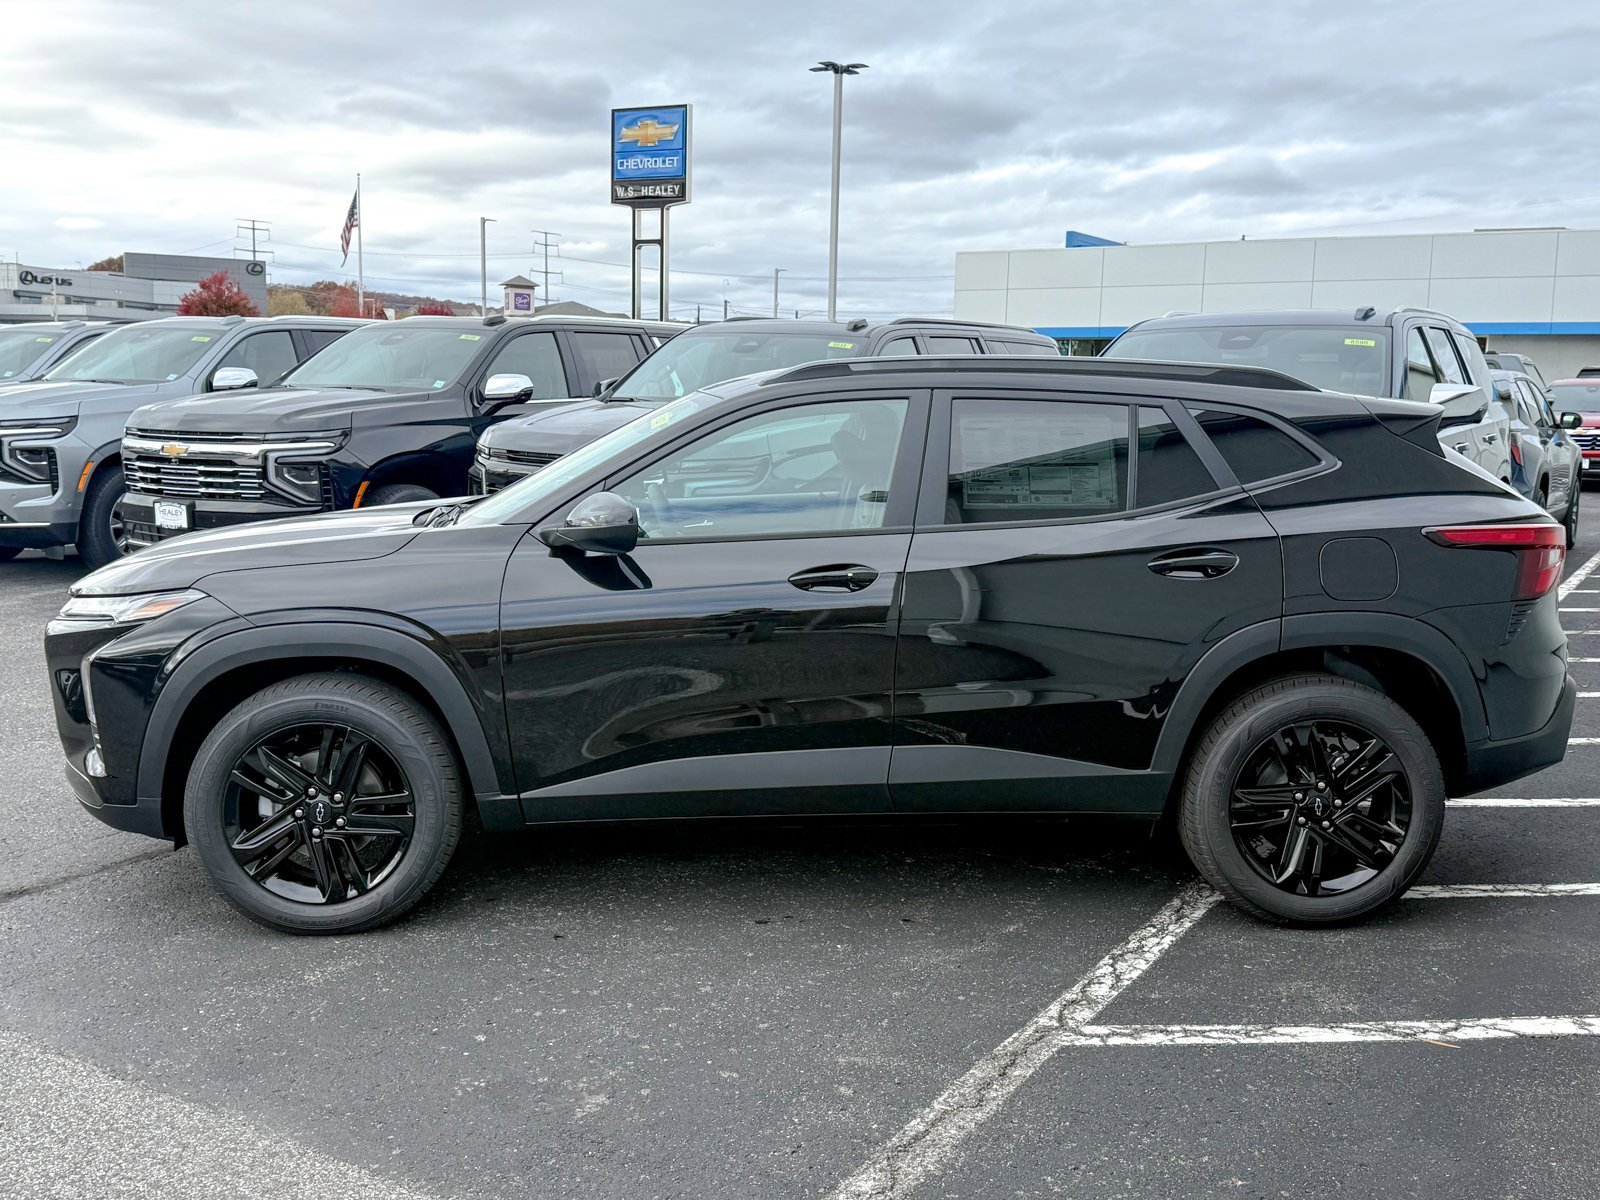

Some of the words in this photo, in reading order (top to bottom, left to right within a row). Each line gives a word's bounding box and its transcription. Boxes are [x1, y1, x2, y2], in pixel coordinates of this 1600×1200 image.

[617, 156, 679, 170] CHEVROLET
[616, 186, 637, 197] W.S.
[641, 184, 680, 196] HEALEY
